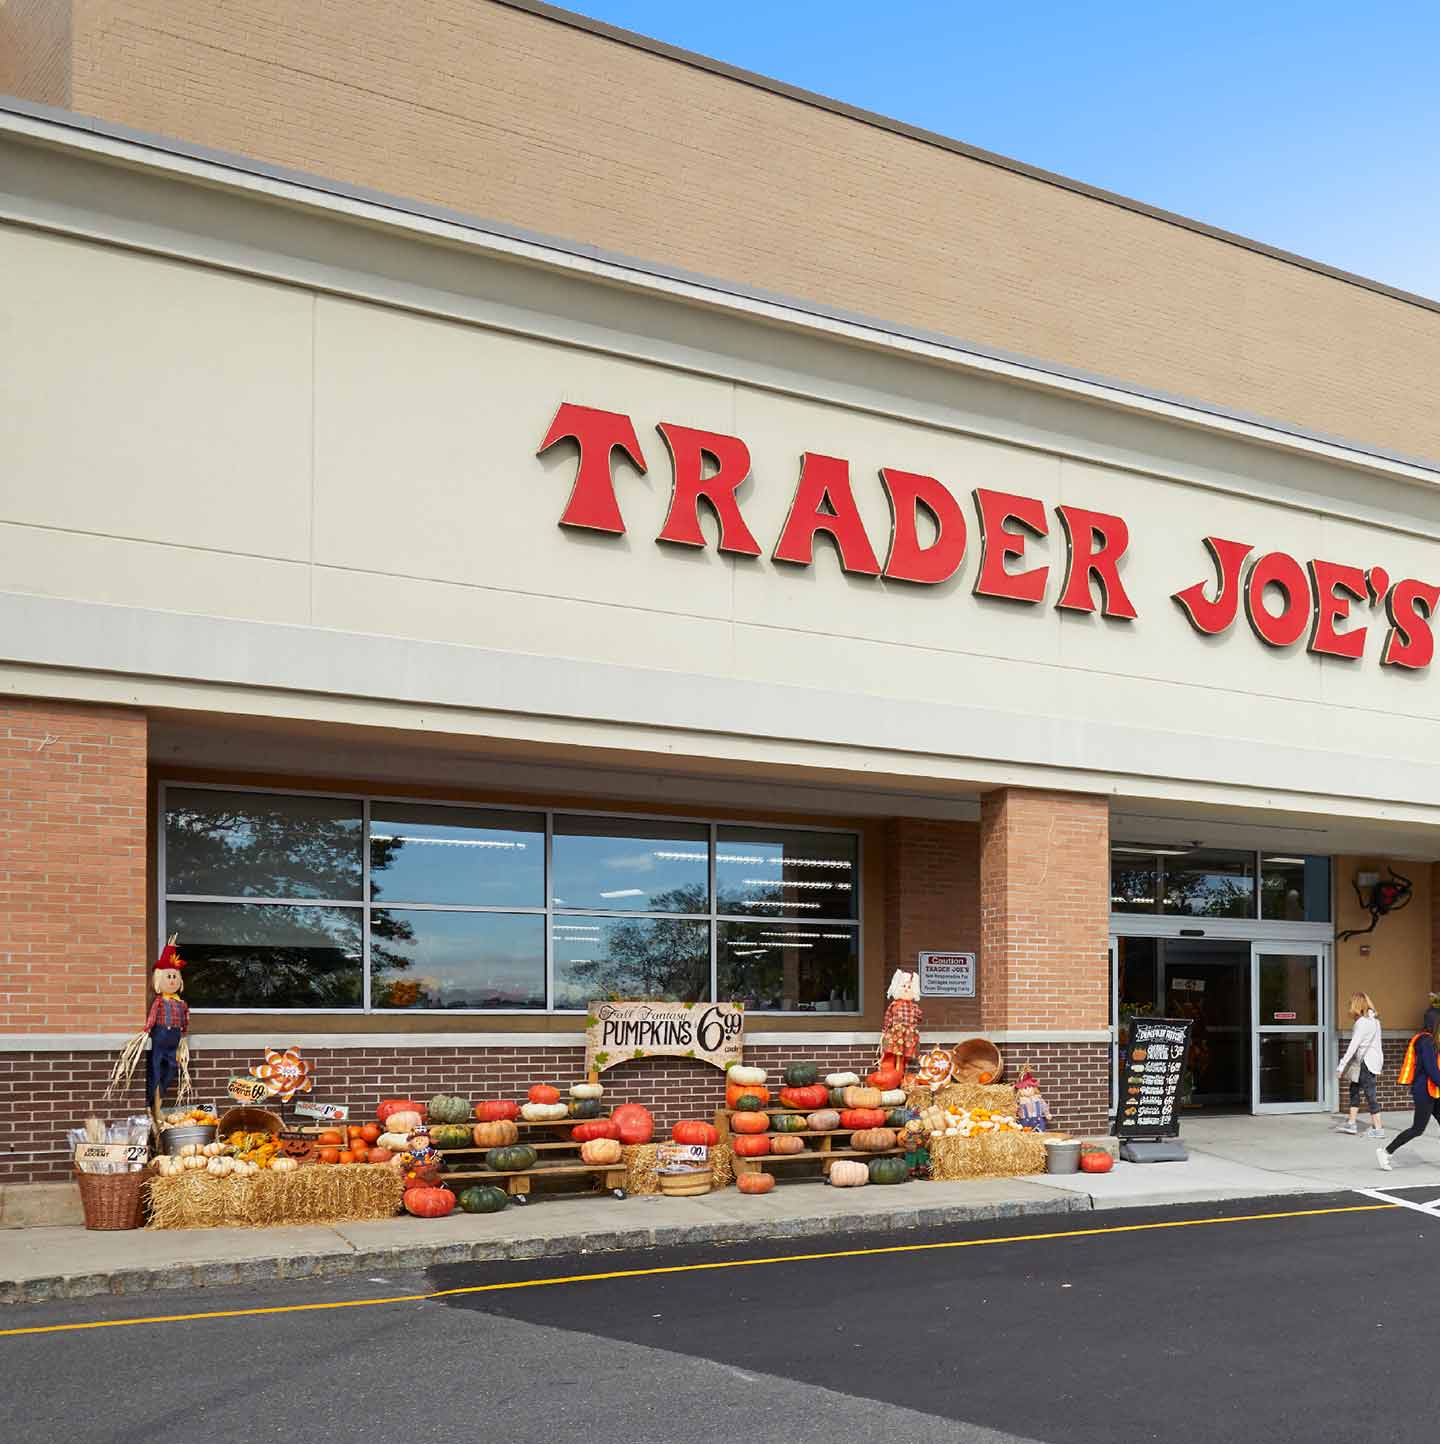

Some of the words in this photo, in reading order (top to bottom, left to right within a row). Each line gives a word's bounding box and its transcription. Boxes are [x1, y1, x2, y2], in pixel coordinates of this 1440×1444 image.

[536, 402, 1138, 622] TRADER
[932, 957, 963, 965] Caution
[603, 1021, 692, 1045] PUMPKINS
